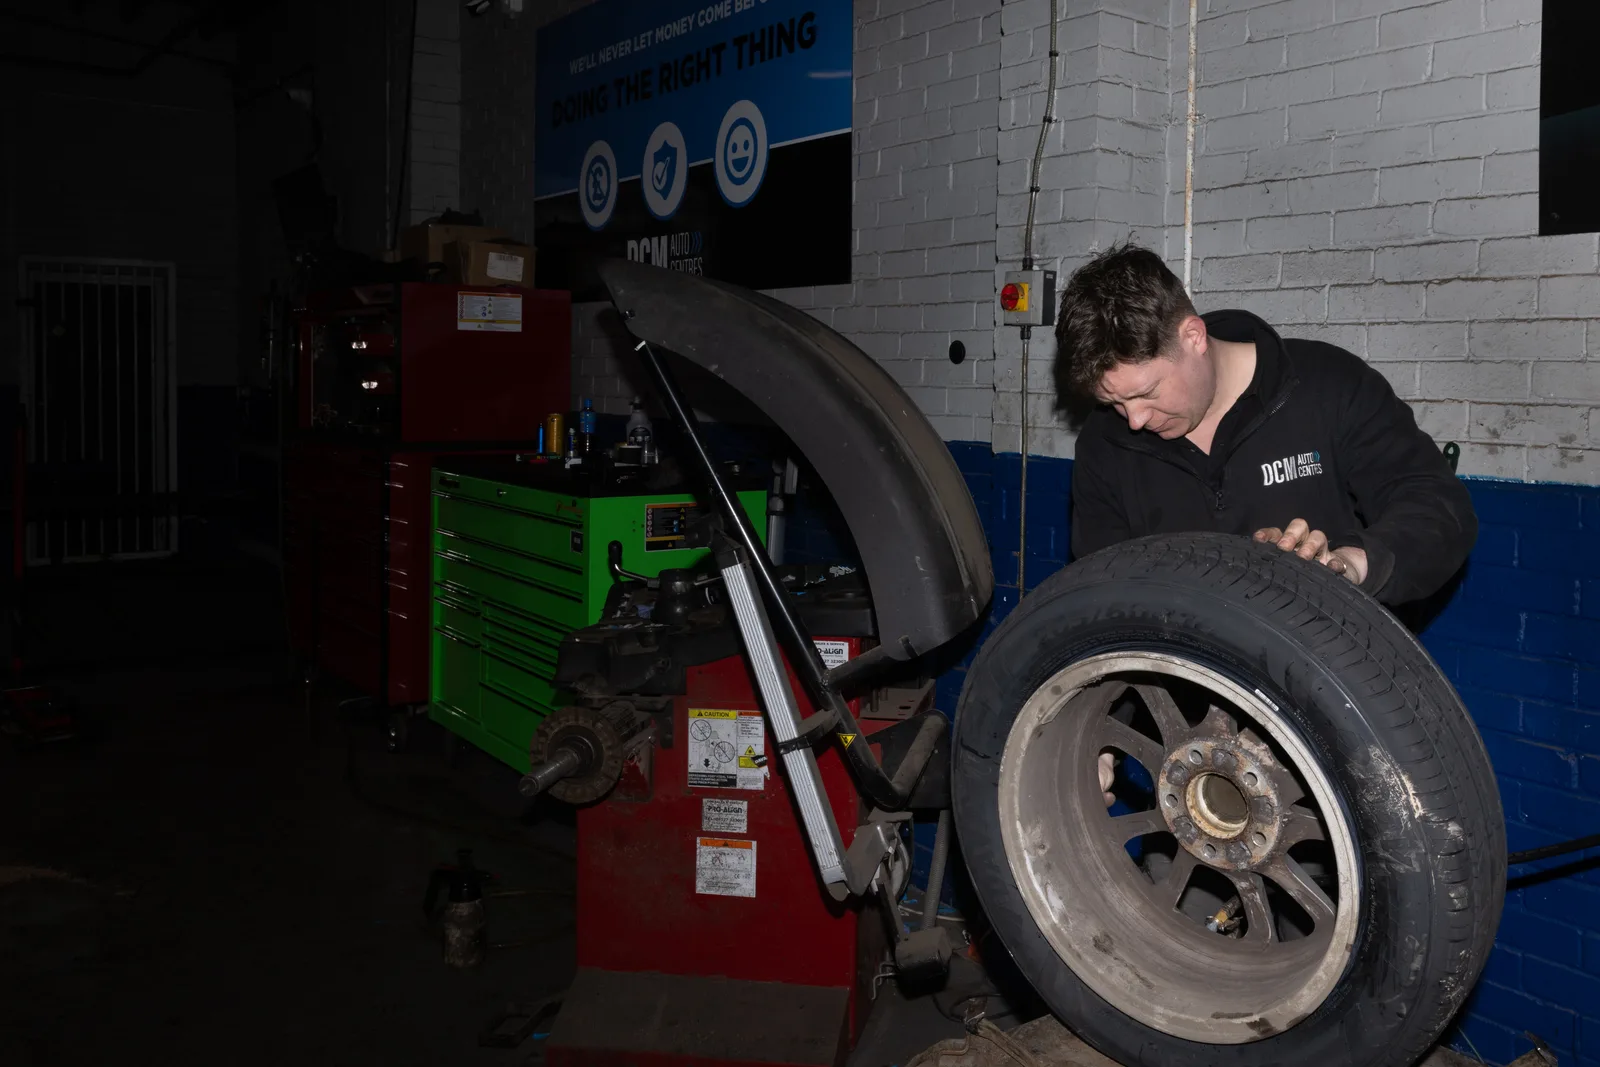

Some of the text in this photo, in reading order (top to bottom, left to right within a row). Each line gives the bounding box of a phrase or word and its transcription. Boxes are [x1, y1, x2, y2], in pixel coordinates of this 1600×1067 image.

[569, 53, 597, 75] WE'LL
[599, 41, 632, 65] NEVER
[633, 31, 653, 53] LET
[655, 15, 696, 45] MONEY
[698, 0, 733, 28] COME
[552, 12, 816, 129] DOING THE RIGHT THING
[670, 232, 690, 257] AUTO
[1261, 456, 1297, 486] DCM
[1297, 452, 1314, 465] AUTO
[1298, 463, 1322, 477] CENTRES
